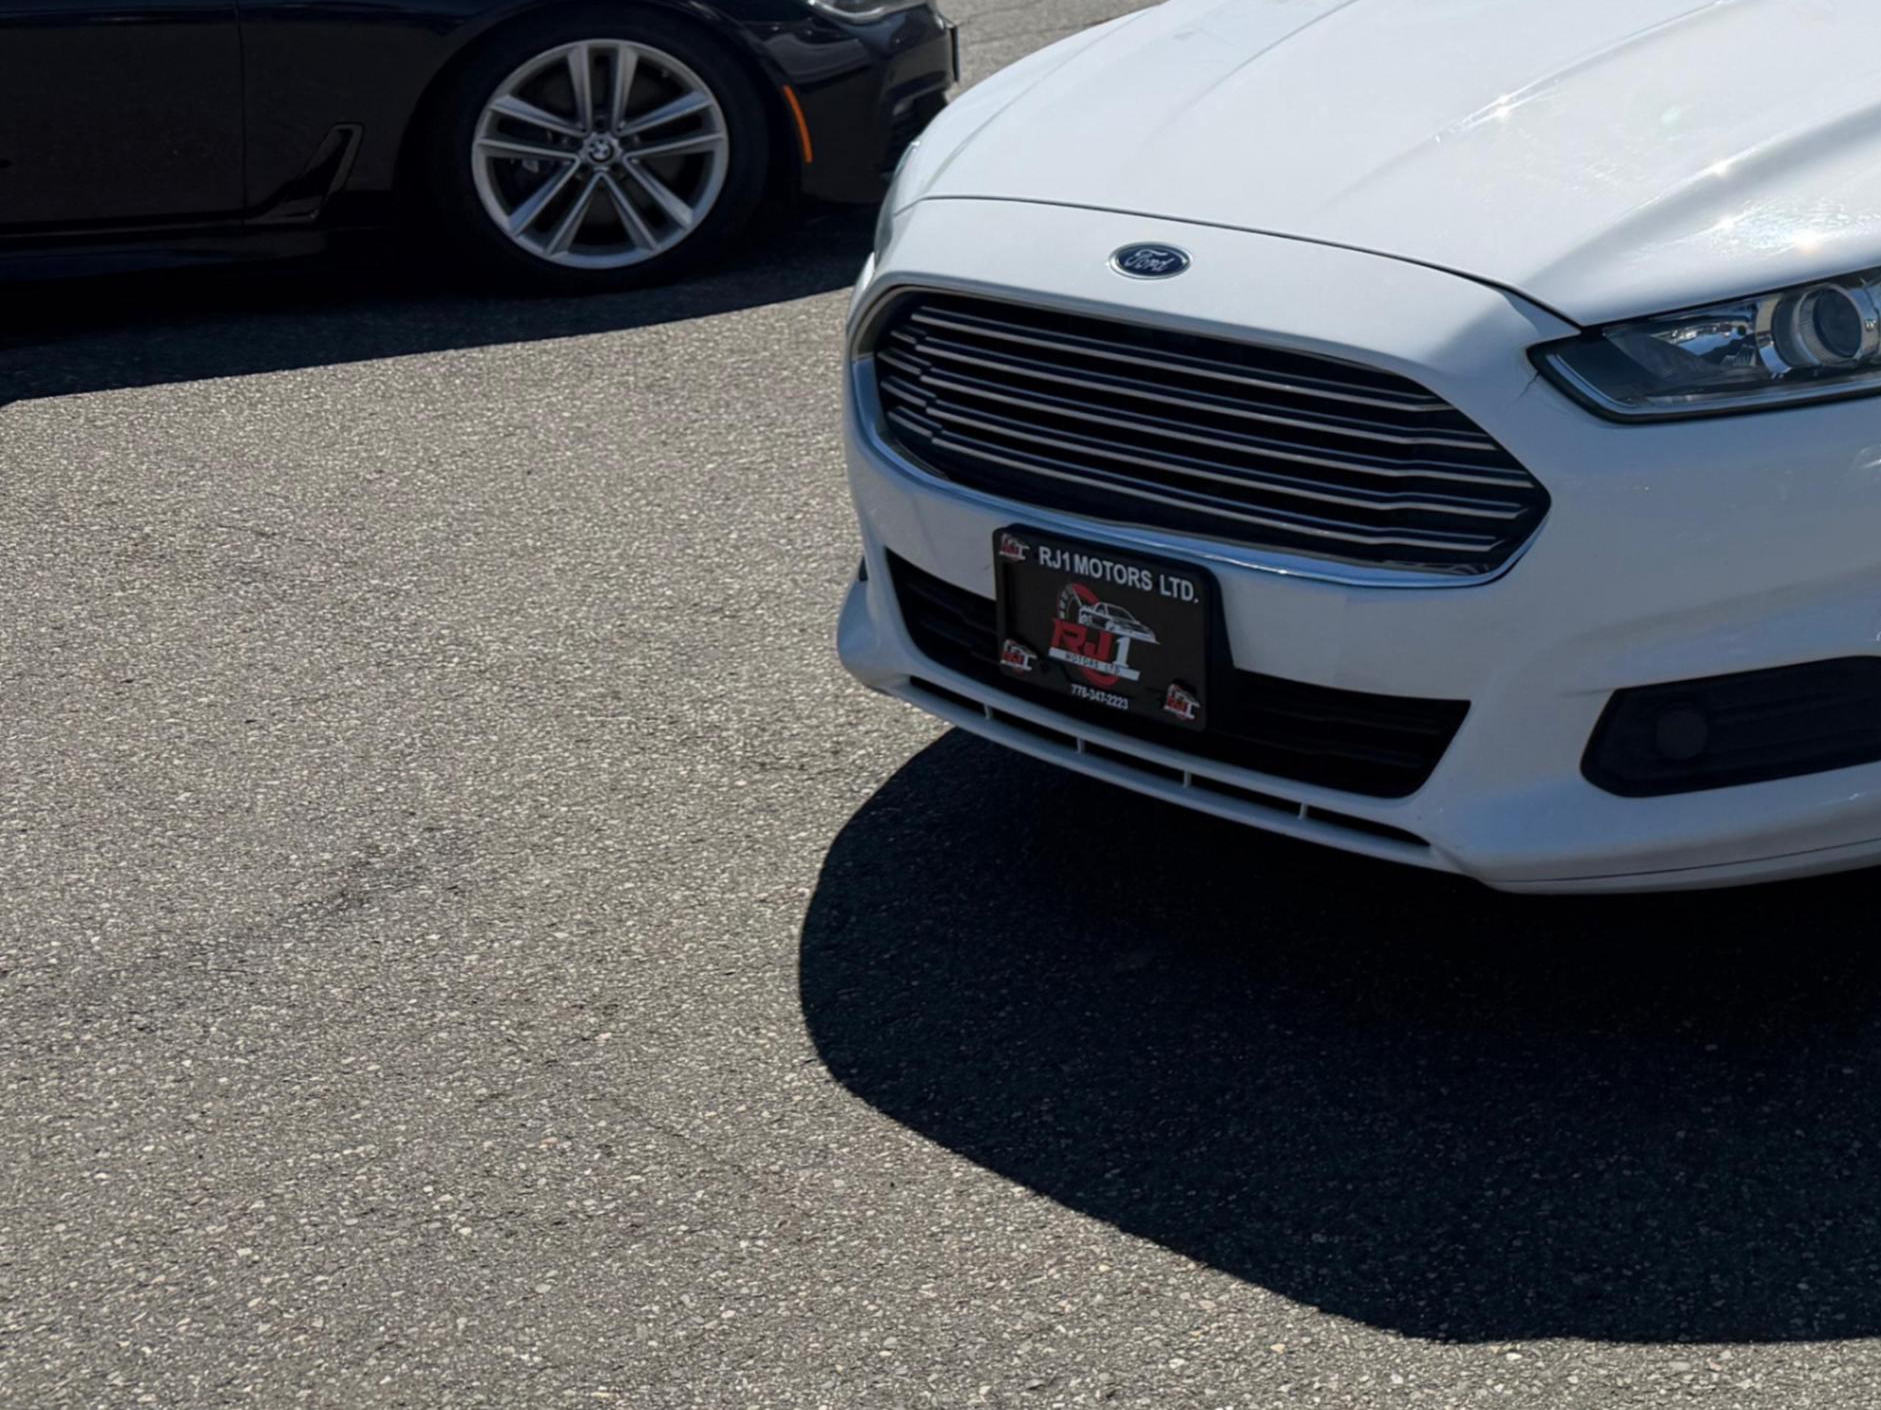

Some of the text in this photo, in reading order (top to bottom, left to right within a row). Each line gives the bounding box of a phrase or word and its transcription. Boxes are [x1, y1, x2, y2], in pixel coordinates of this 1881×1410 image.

[1124, 249, 1176, 272] Ford
[1038, 546, 1071, 570] RJ1
[1074, 554, 1153, 591] MOTORS
[1159, 574, 1200, 604] LTD.
[1052, 617, 1131, 668] RJ1
